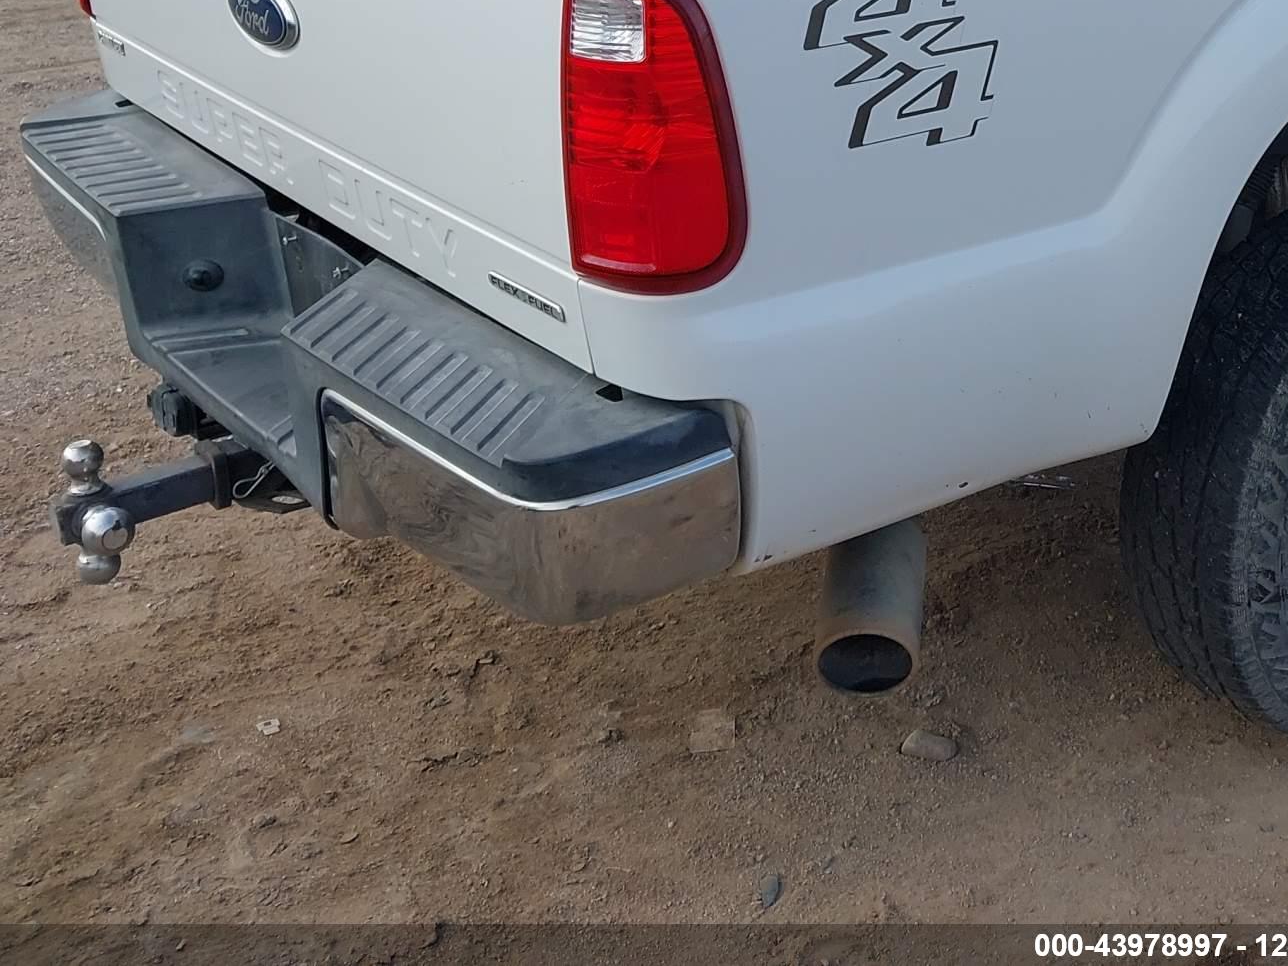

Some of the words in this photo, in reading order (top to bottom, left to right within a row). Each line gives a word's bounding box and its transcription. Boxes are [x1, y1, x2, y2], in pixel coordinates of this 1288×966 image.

[157, 70, 294, 185] SUPER
[318, 160, 457, 277] DUTY
[490, 274, 520, 299] FLEX
[527, 294, 561, 322] FUEL
